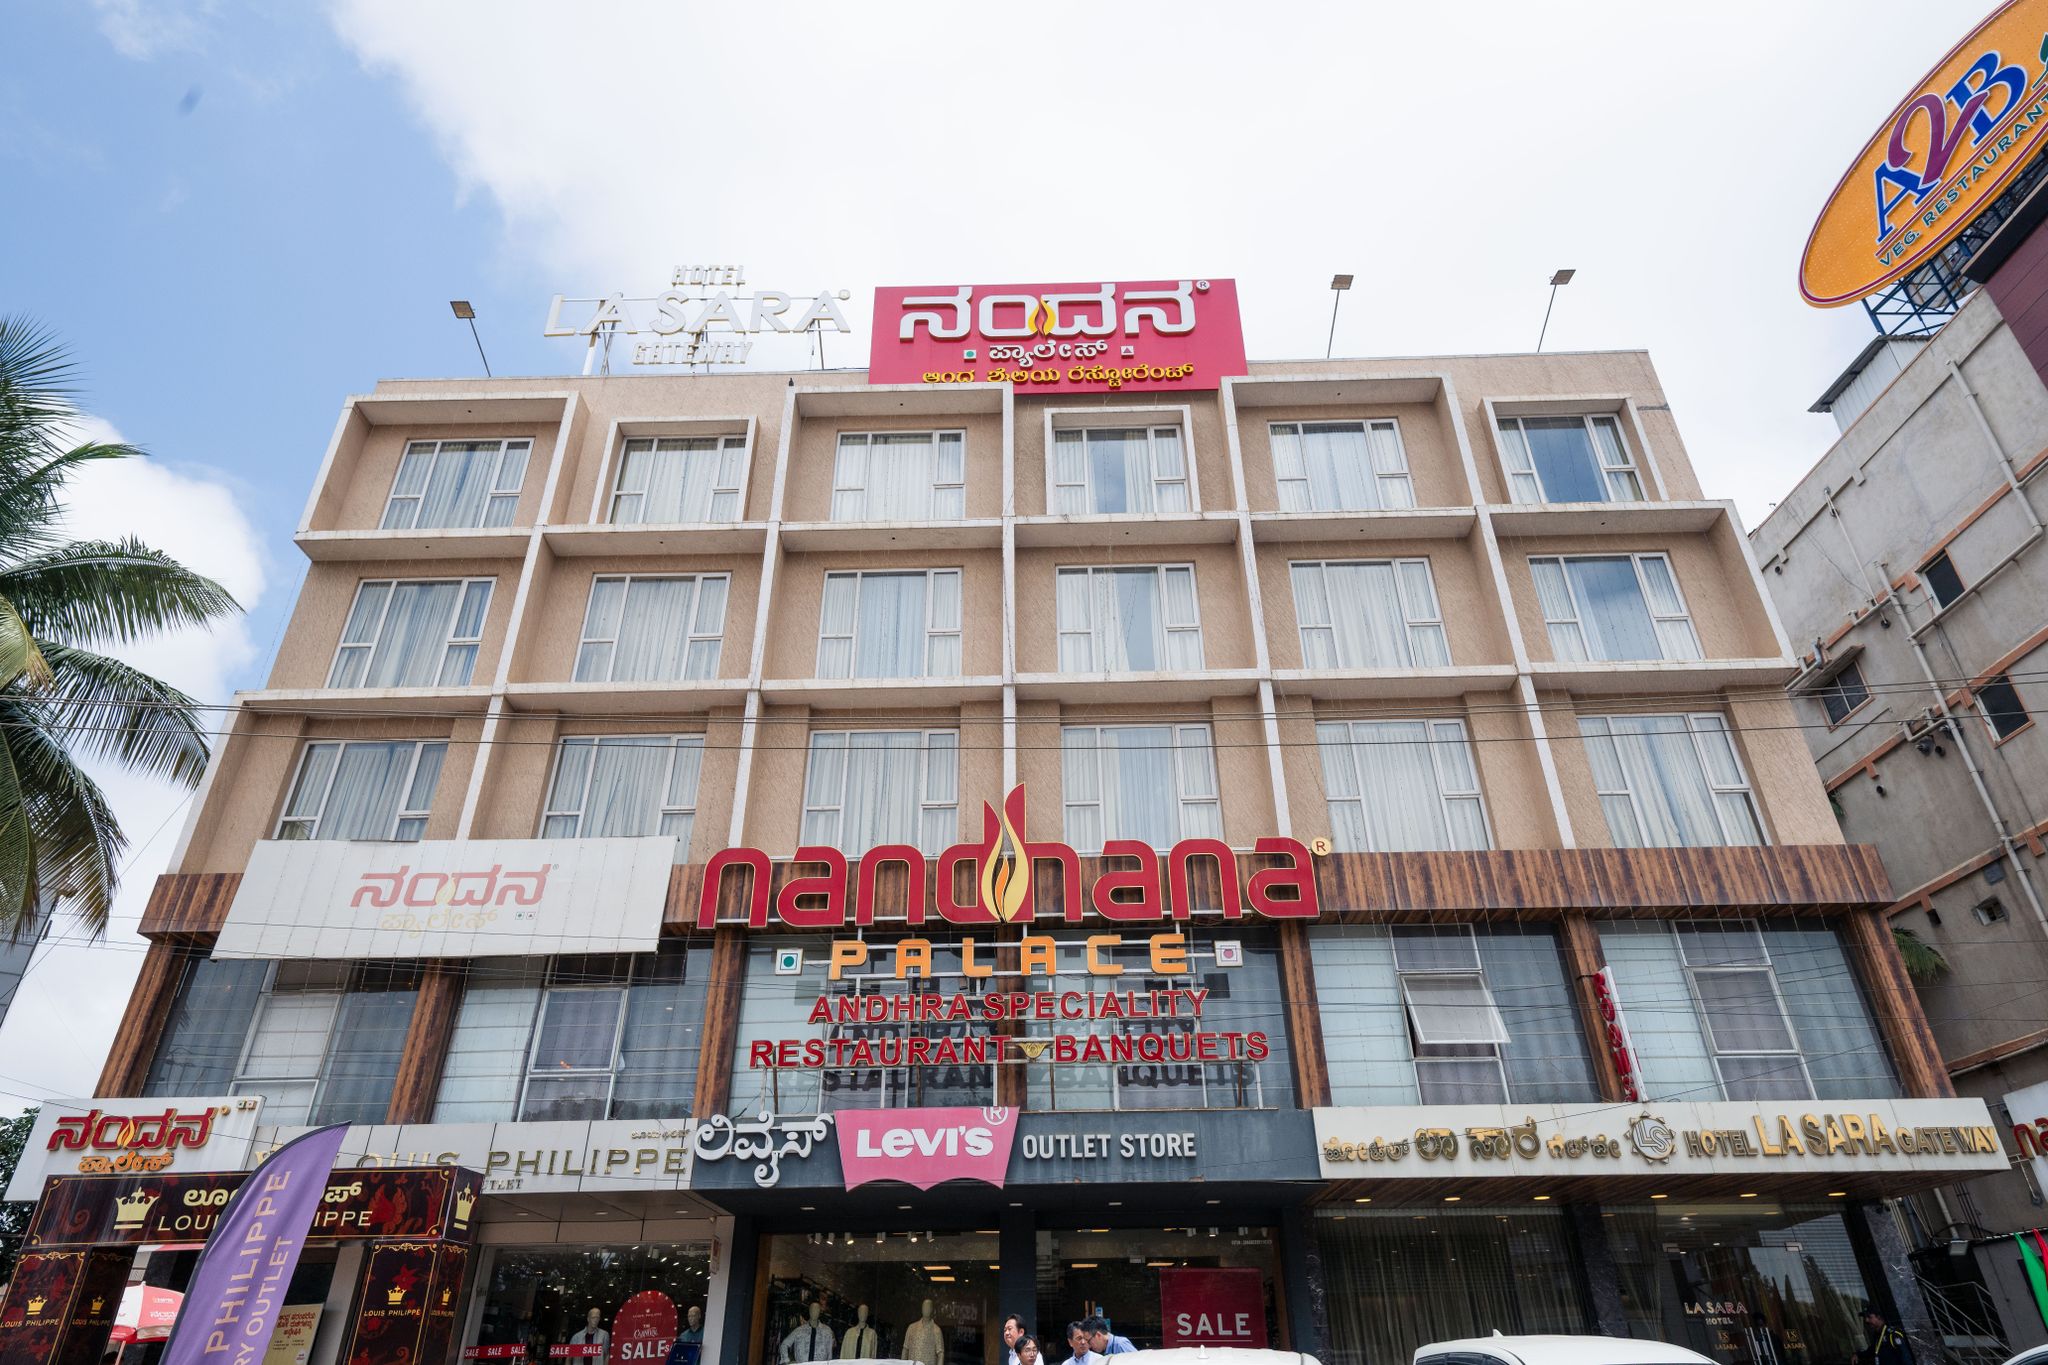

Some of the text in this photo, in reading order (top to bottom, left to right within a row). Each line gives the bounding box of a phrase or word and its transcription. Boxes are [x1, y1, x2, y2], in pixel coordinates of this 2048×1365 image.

[1874, 50, 2028, 243] A2B
[1880, 229, 1920, 266] VEG.
[672, 265, 745, 285] HOTEL
[544, 290, 851, 337] LA SARA
[900, 281, 1197, 342] ನಂದನ
[632, 341, 754, 365] GATEWAY
[989, 339, 1108, 367] ಪ್ಯಾಲೇಸ್
[697, 782, 1320, 929] nandhana
[350, 864, 552, 908] ನಂದನ
[832, 933, 1190, 980] PALACE
[808, 988, 1210, 1025] ANDHRA SPECIALITY
[750, 1031, 1270, 1068] RESTAURANT BANQUETS
[47, 1107, 219, 1151] ನಂದನ
[1684, 1113, 1999, 1158] HOTEL LA SARA GATEWAY
[1022, 1133, 1111, 1160] OUTLET
[1119, 1132, 1197, 1158] STORE
[1414, 1127, 1459, 1161] ಲಾ
[485, 1147, 689, 1178] PHILIPPE
[157, 1211, 373, 1231] LOUI IPPE
[204, 1170, 292, 1354] PHILIPPE
[246, 1236, 293, 1337] OUTLET
[388, 1309, 421, 1317] PHILIPPE
[1684, 1301, 1748, 1314] LA SARA
[1706, 1317, 1733, 1325] HOTEL
[0, 1318, 60, 1328] LOUIS PHILIPPE
[1177, 1313, 1251, 1336] SALE
[465, 1348, 479, 1357] SALE
[487, 1347, 502, 1356] SALE
[511, 1345, 526, 1354] SALE
[550, 1346, 570, 1355] SALE
[582, 1345, 602, 1354] SALE
[621, 1340, 667, 1360] SALE
